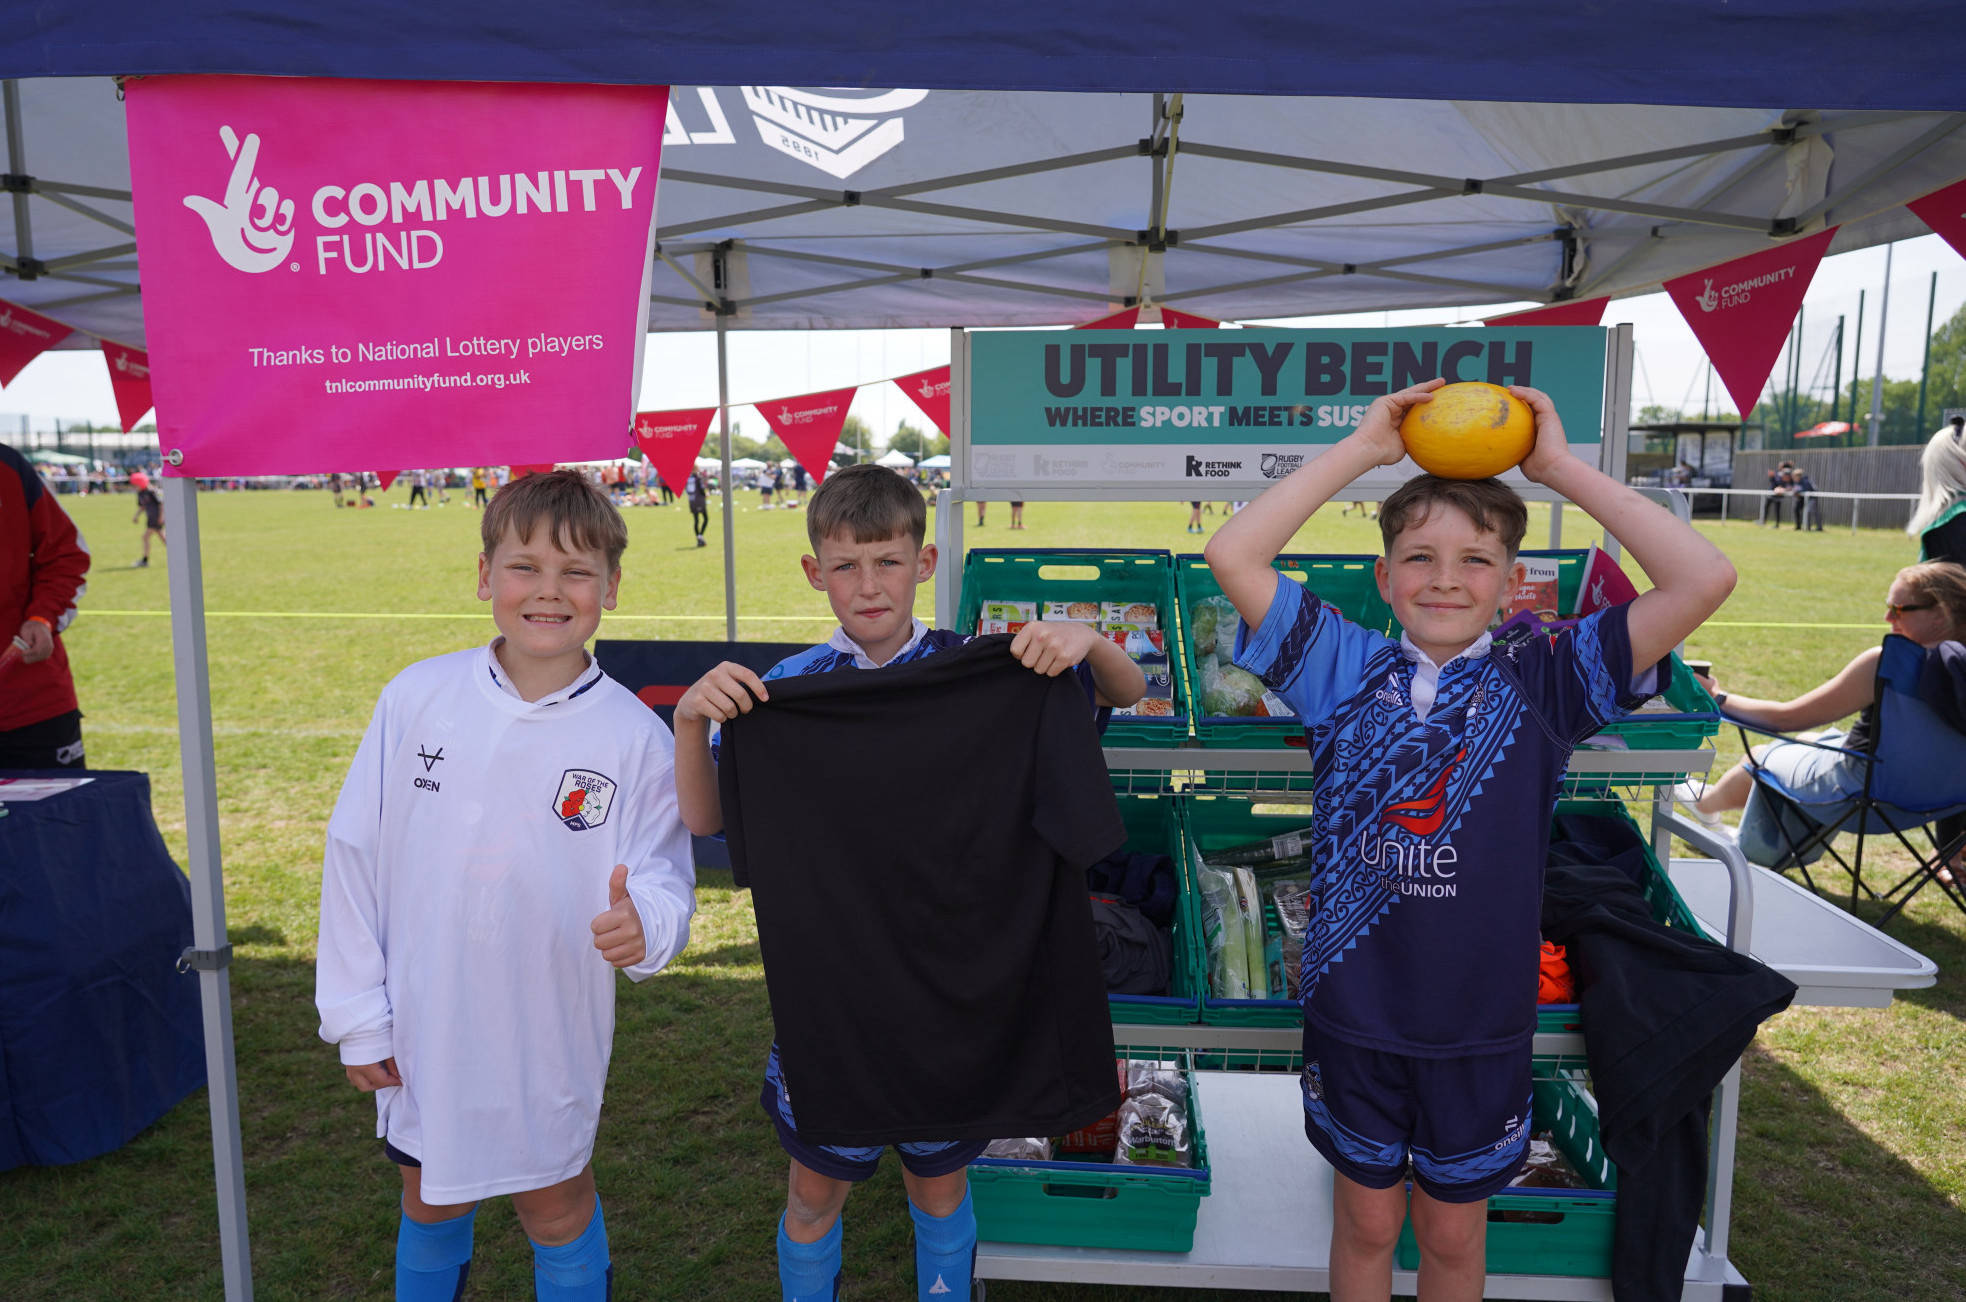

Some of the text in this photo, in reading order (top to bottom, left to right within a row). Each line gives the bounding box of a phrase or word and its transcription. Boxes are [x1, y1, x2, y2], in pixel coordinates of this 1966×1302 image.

[311, 165, 643, 228] COMMUNITY
[316, 229, 444, 275] FUND
[1722, 266, 1795, 297] COMMUNITY
[1721, 293, 1751, 309] FUND
[249, 332, 604, 367] Thanks to National Lottery players
[1044, 340, 1533, 398] UTILITY BENCH
[325, 370, 530, 393] tnlcommunityfund.org.uk
[1044, 406, 1136, 428] WHERE
[1139, 405, 1226, 428] SPORT
[1228, 405, 1314, 427] MEETS
[1205, 461, 1242, 470] RETHINK
[1278, 454, 1304, 463] RUGBY
[1530, 567, 1556, 577] from
[414, 778, 440, 792] OXEN
[572, 773, 587, 782] WAR
[597, 780, 609, 788] THE
[575, 780, 602, 793] ROSES
